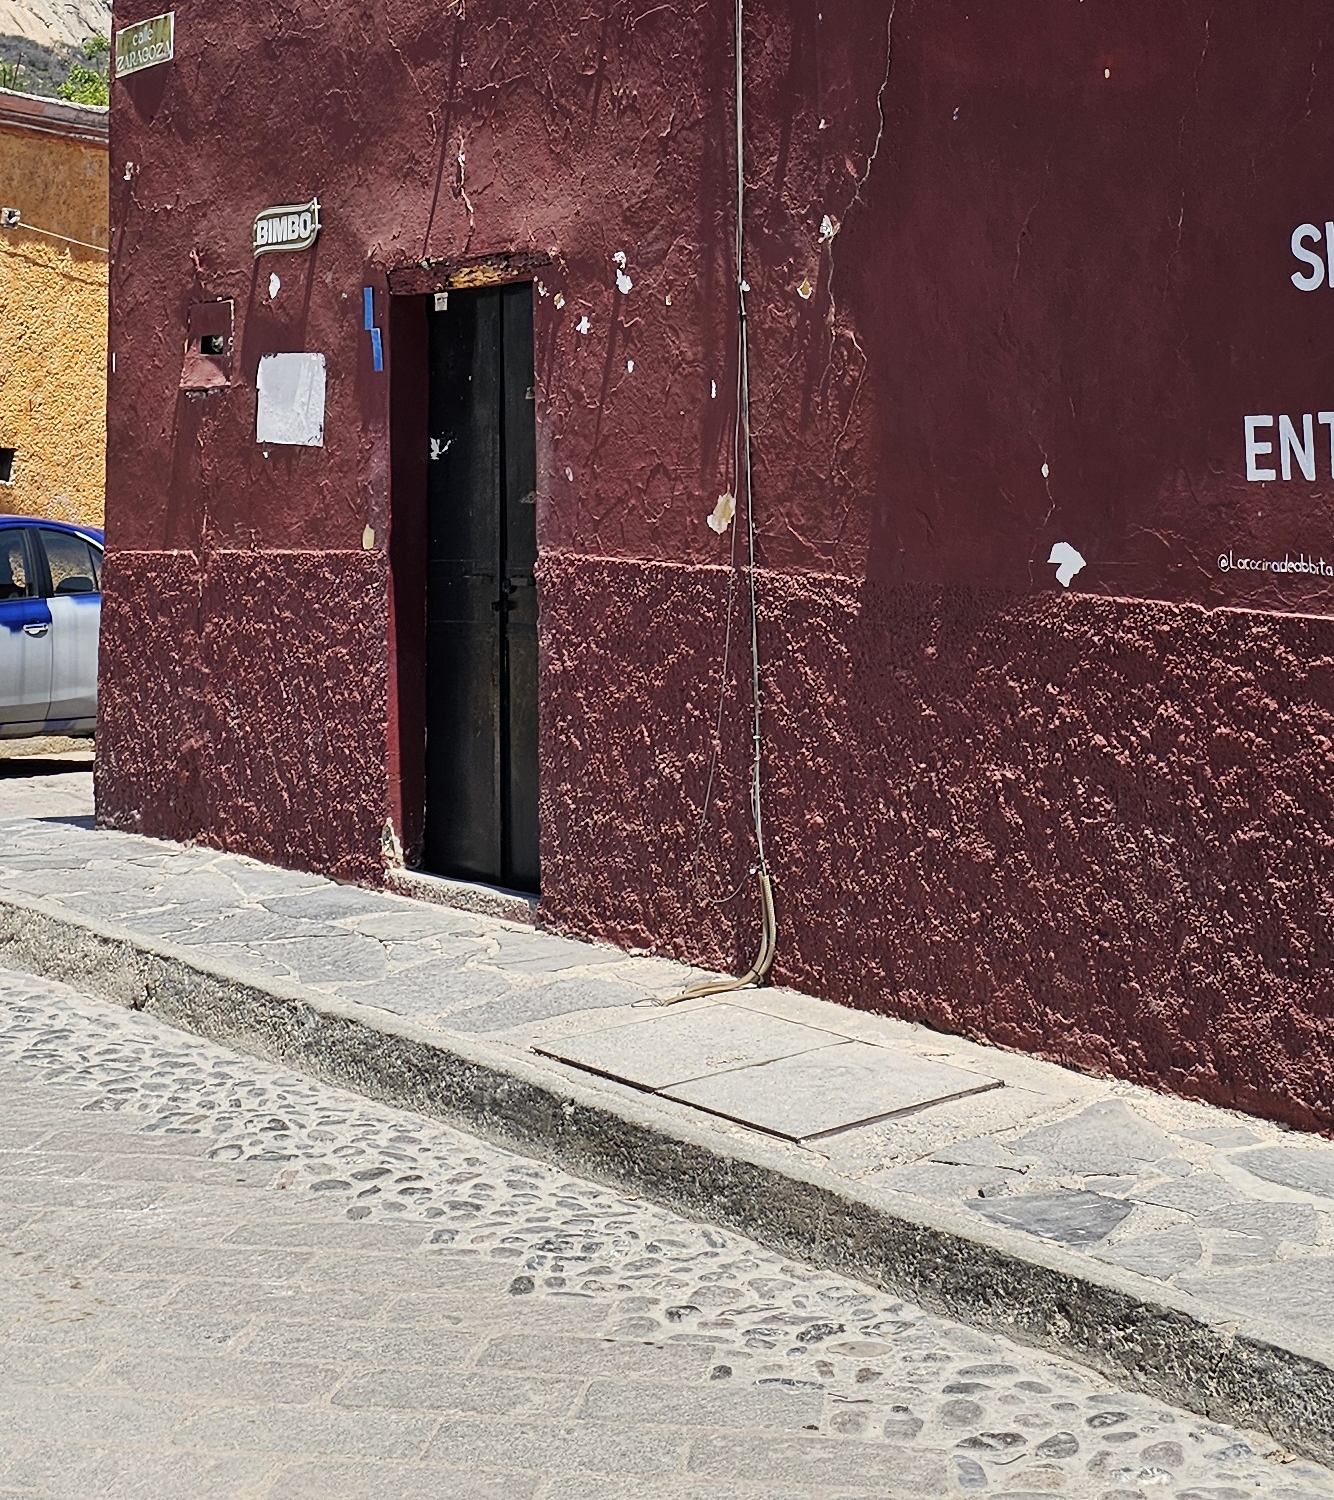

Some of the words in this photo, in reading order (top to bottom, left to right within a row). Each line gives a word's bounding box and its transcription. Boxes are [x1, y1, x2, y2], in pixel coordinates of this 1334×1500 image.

[132, 26, 154, 46] calle
[117, 41, 172, 72] ZARAGOZA
[257, 211, 312, 246] BIMBO
